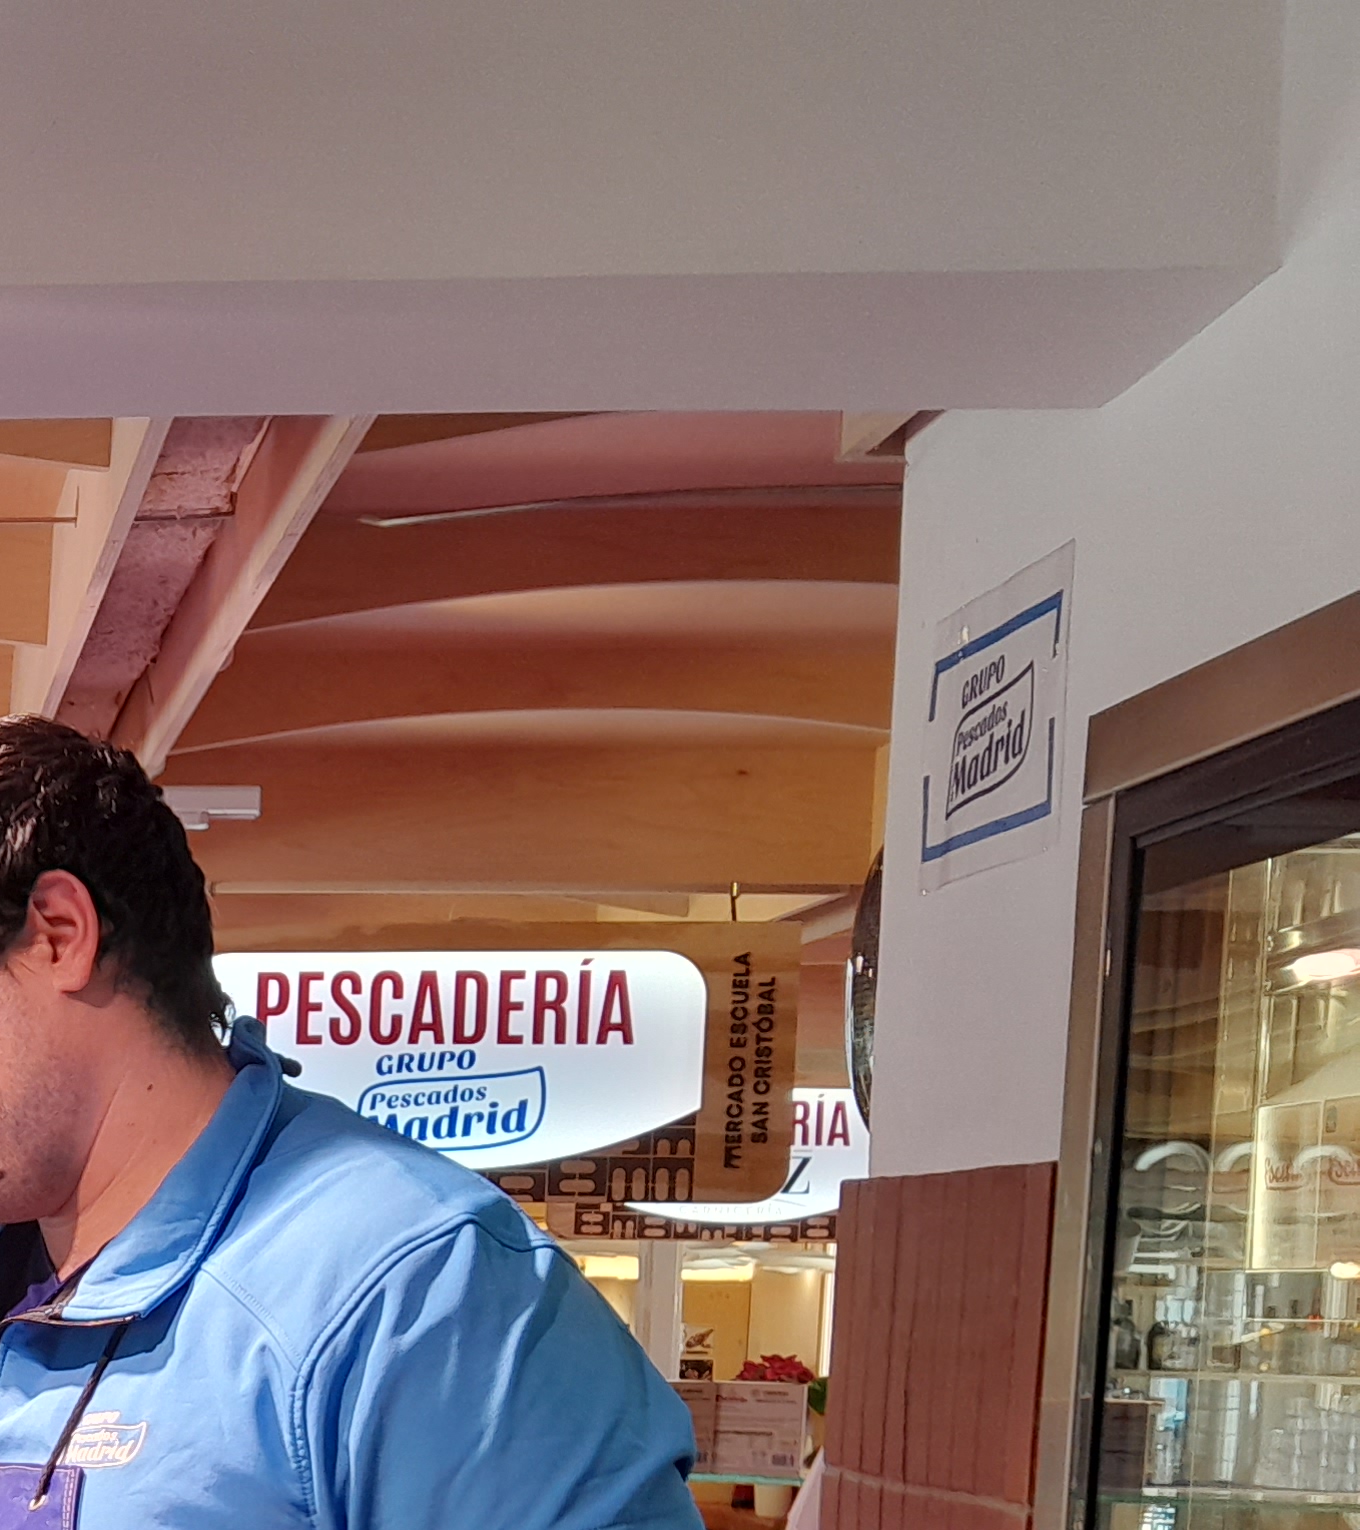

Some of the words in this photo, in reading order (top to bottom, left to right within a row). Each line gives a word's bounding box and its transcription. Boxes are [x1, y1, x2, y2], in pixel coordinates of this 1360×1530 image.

[961, 655, 1005, 709] GRUPO
[950, 709, 1026, 803] Madrid
[956, 700, 1008, 757] Pescados
[256, 957, 634, 1046] PESCADERÍA
[730, 951, 752, 1048] ESCUELA
[376, 1049, 477, 1076] GRUPO
[752, 976, 776, 1096] CRISTÓBAL
[370, 1084, 488, 1111] Pescados
[723, 1055, 747, 1169] MERCADO
[751, 1101, 770, 1144] SAN
[65, 1439, 135, 1463] Madrid
